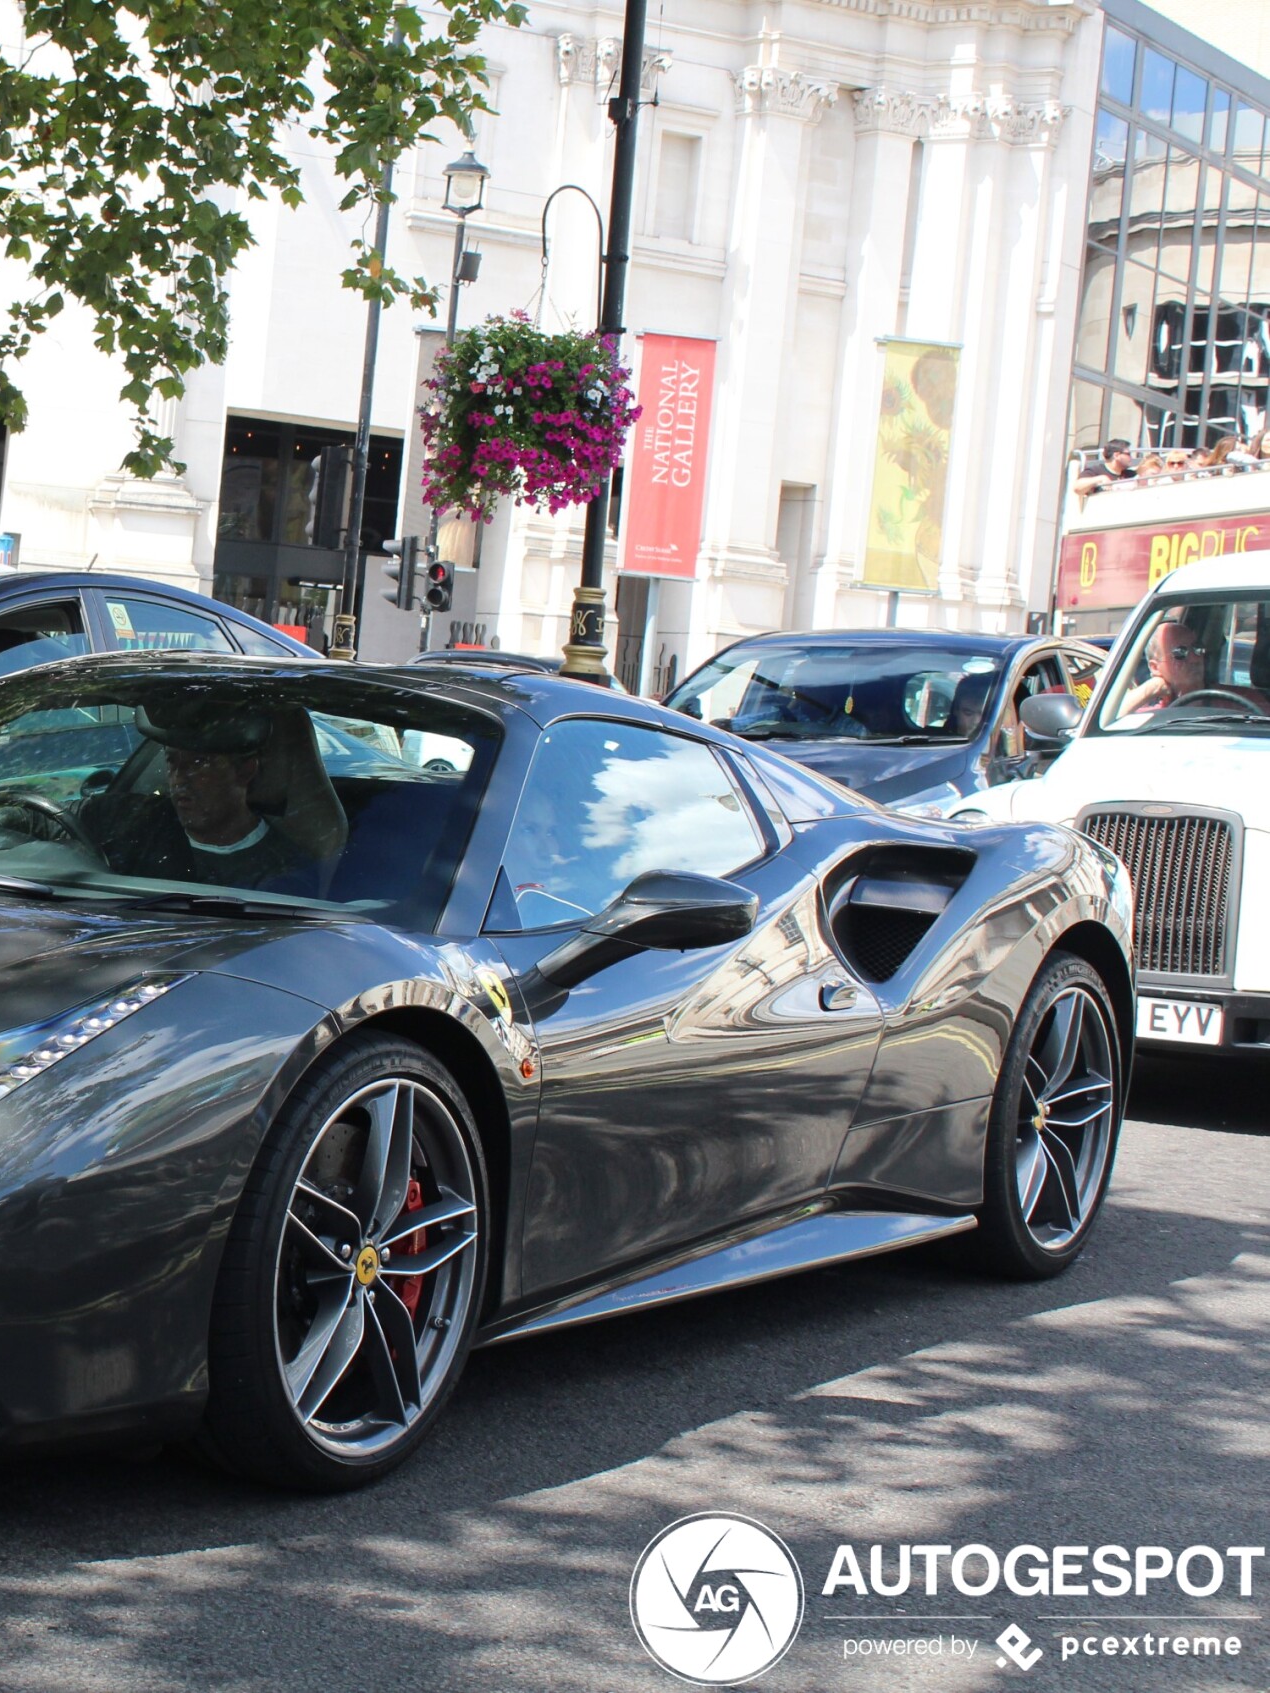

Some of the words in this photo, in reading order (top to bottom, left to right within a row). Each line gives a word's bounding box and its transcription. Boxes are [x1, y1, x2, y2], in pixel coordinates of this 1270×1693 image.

[643, 426, 654, 450] THE
[652, 360, 678, 485] NATIONAL
[671, 361, 700, 487] GALLERY
[1149, 1003, 1214, 1036] EYV
